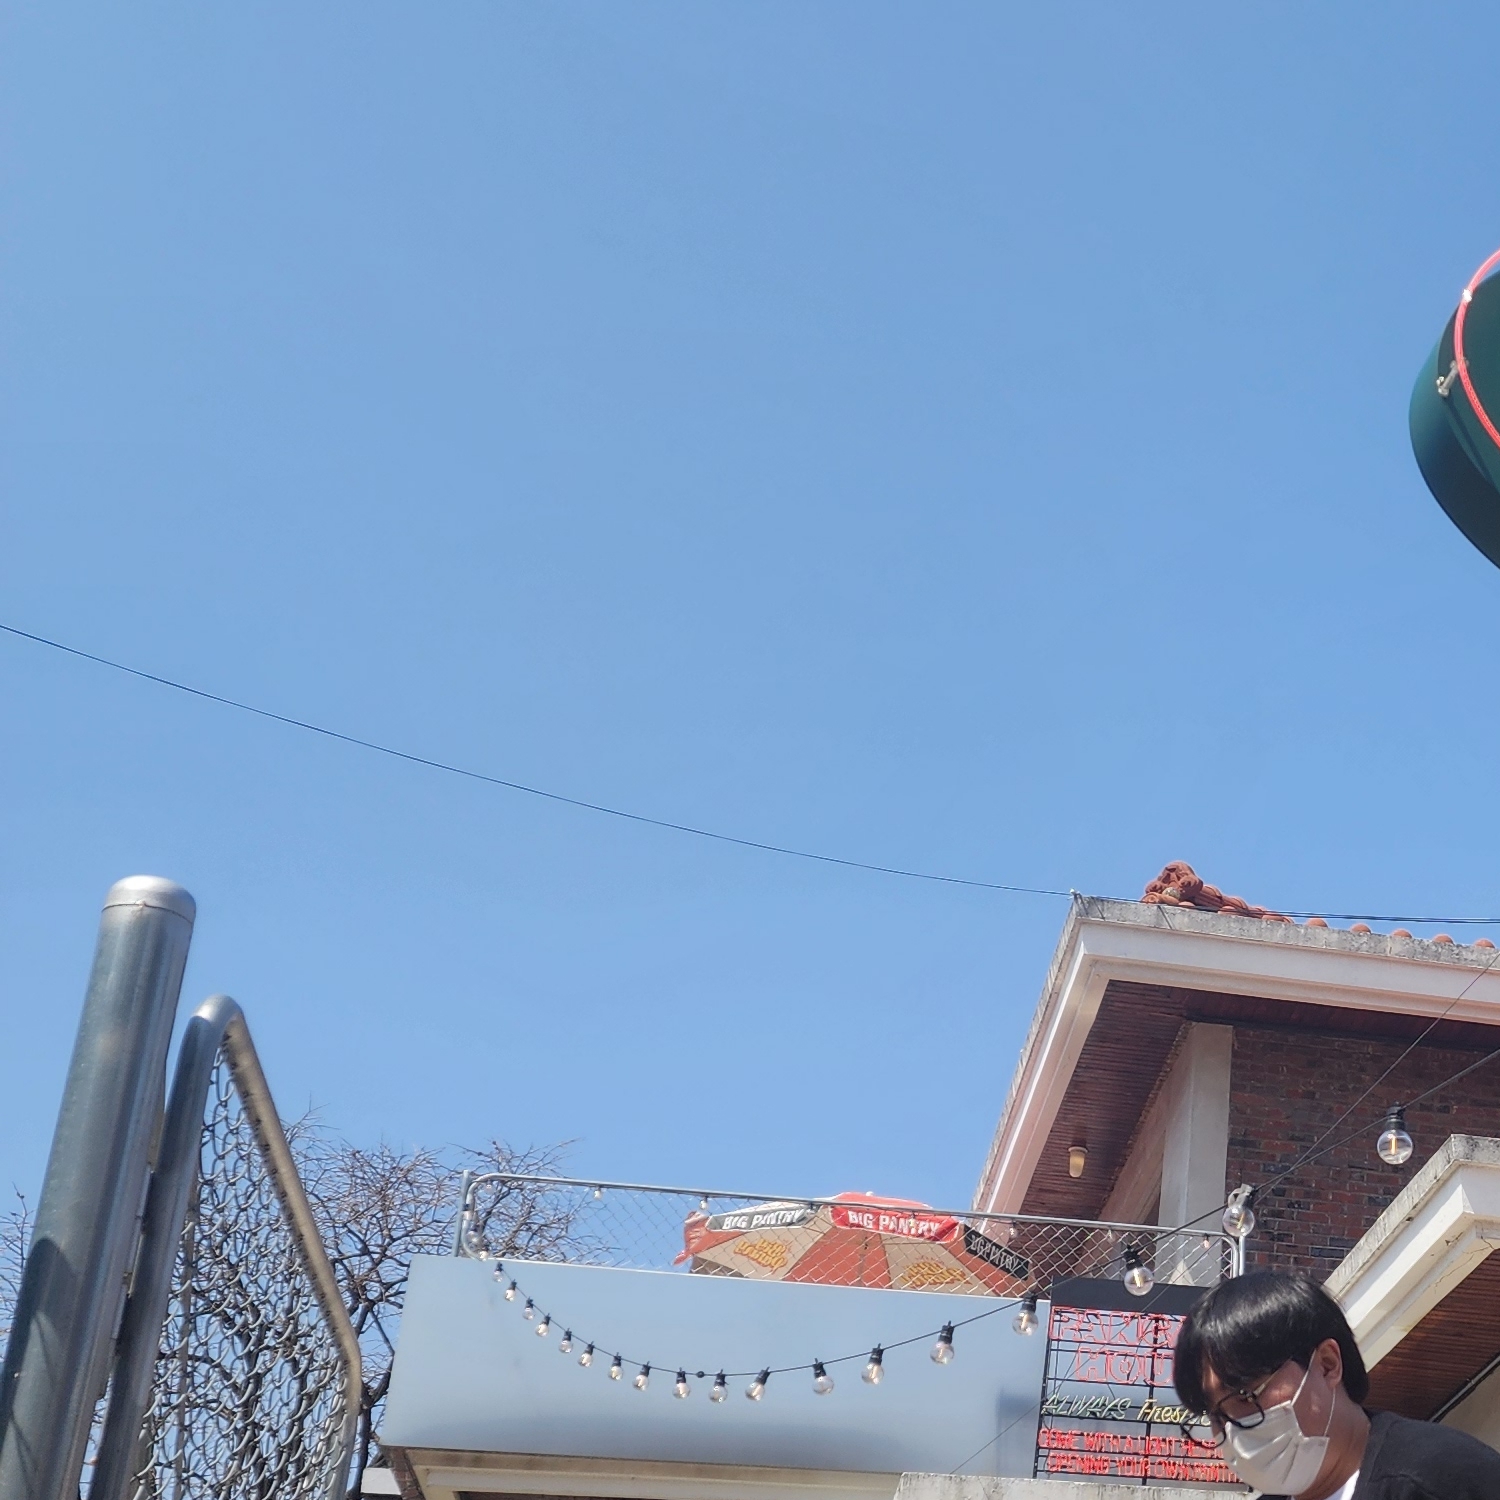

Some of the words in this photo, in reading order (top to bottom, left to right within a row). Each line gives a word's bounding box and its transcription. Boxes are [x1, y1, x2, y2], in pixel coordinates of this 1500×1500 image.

[721, 1215, 750, 1230] BIG
[847, 1210, 874, 1229] BIG
[1076, 1347, 1174, 1386] HOU
